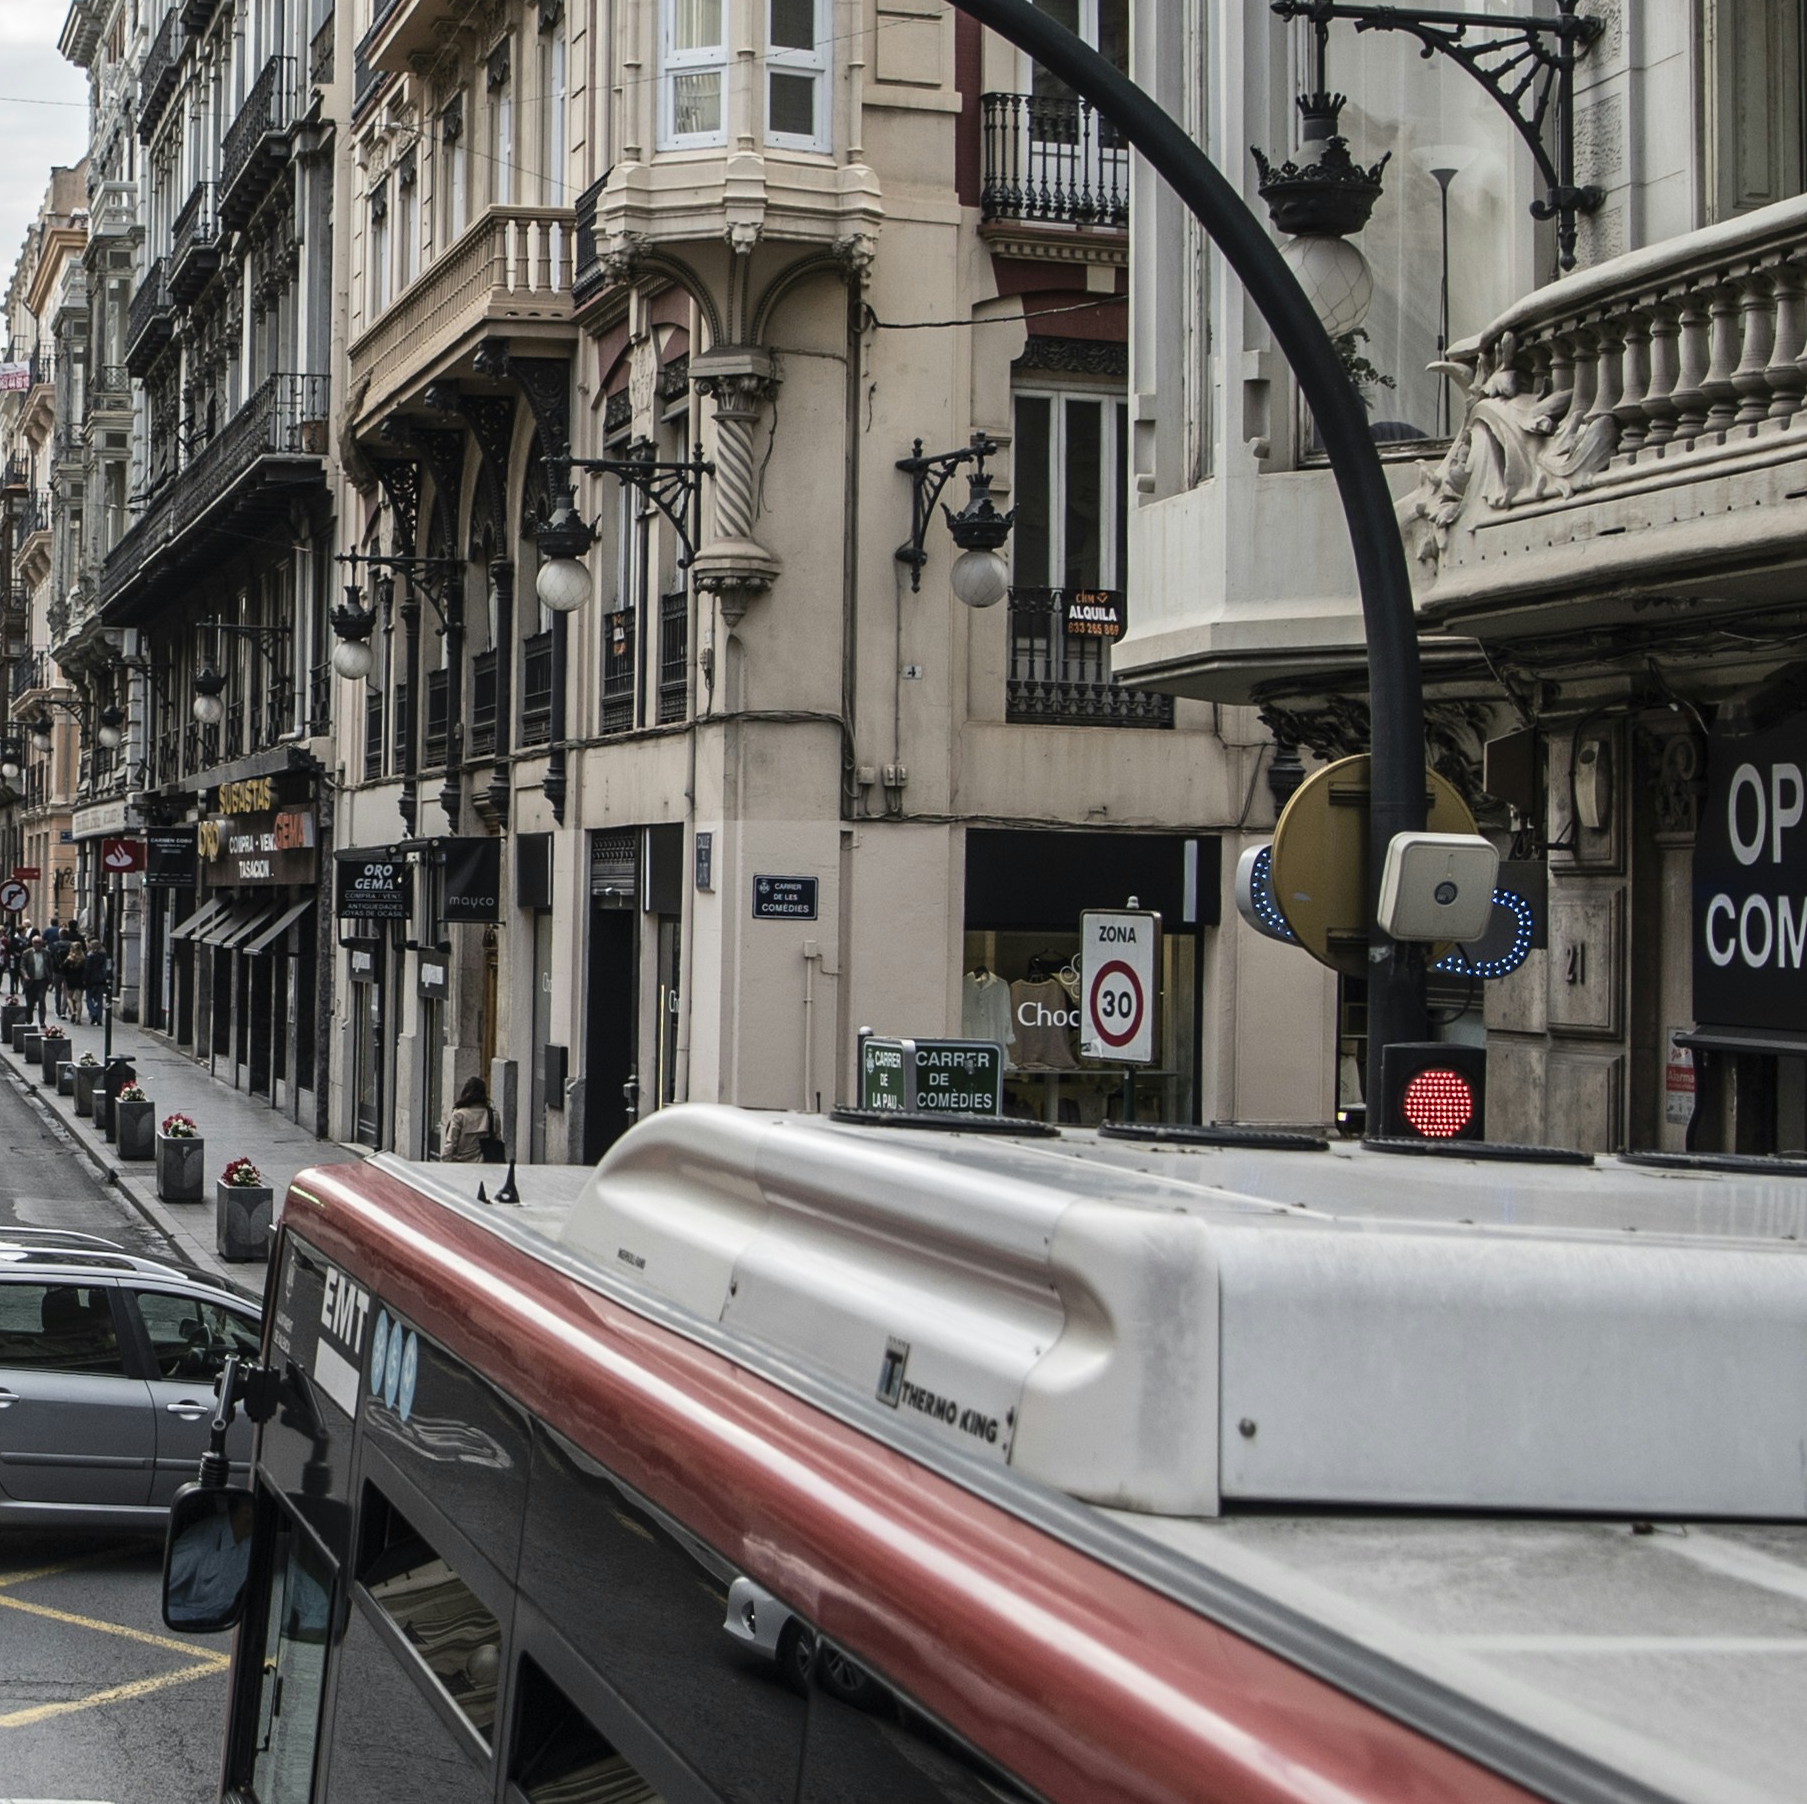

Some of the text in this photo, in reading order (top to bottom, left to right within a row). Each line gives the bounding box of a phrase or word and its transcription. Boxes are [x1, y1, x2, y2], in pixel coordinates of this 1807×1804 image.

[1069, 605, 1117, 622] ALQUILA
[219, 777, 272, 815] SUBASTAS
[274, 812, 305, 849] GEMA
[197, 820, 220, 862] ORO
[229, 835, 254, 854] COMPRA
[364, 864, 393, 879] ORO
[355, 878, 393, 890] GEMA
[774, 882, 802, 891] CARRER
[449, 895, 494, 909] mayco
[773, 893, 782, 901] DE
[1099, 926, 1137, 944] ZONA
[1565, 943, 1585, 984] 21
[1102, 990, 1133, 1019] 30
[874, 1050, 902, 1069] CARRER
[915, 1051, 990, 1068] CARRER
[879, 1073, 889, 1087] DE
[929, 1073, 949, 1086] DE
[872, 1092, 882, 1108] LA
[917, 1088, 993, 1109] COMÈDIES
[321, 1265, 370, 1355] EMT
[902, 1381, 998, 1443] THERMO KING
